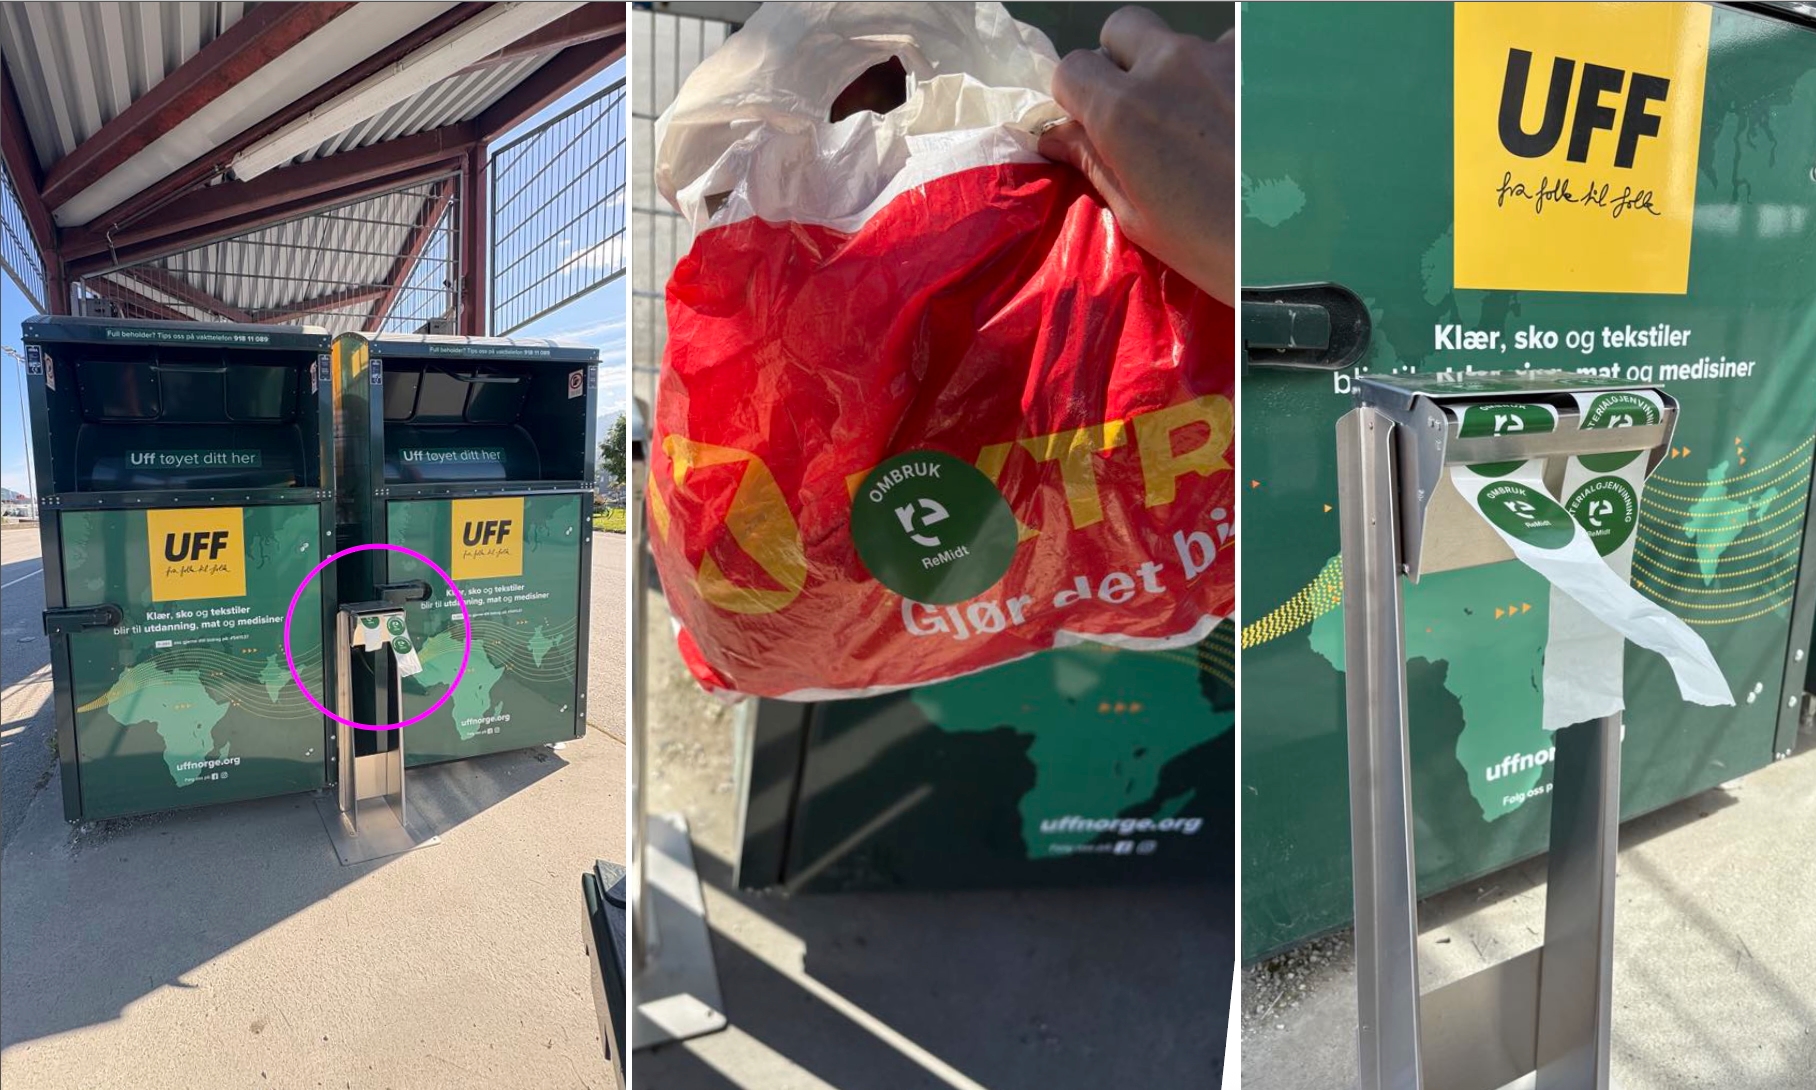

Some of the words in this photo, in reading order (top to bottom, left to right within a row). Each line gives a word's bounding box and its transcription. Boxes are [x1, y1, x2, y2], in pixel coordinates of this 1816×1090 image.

[1498, 47, 1671, 170] UFF
[1496, 171, 1533, 208] fra
[1580, 181, 1608, 208] til
[1434, 324, 1507, 353] Klær,
[1514, 324, 1558, 351] sko
[1565, 328, 1595, 354] og
[1601, 325, 1692, 350] tekstiler
[1659, 356, 1756, 381] medisiner
[131, 452, 155, 465] Uff
[160, 453, 199, 469] tøyet
[203, 451, 228, 465] ditt
[232, 451, 256, 465] her
[403, 450, 423, 462] Uff
[426, 449, 457, 465] tøyet
[460, 448, 480, 462] ditt
[483, 448, 501, 461] her
[869, 462, 941, 503] OMBRUK
[1486, 486, 1527, 499] OMBRUK
[463, 519, 512, 547] UFF
[165, 530, 229, 563] UFF
[922, 545, 970, 569] ReMidt
[420, 601, 433, 610] blir
[487, 594, 502, 604] mat
[503, 595, 513, 603] og
[514, 591, 550, 601] medisiner
[468, 587, 482, 596] sko
[483, 587, 494, 595] og
[495, 584, 525, 593] tekstiler
[146, 610, 173, 621] Klær,
[176, 609, 193, 619] sko
[196, 609, 209, 618] og
[211, 605, 251, 616] tekstiler
[901, 593, 1034, 640] Gjør
[113, 626, 130, 636] blir
[132, 624, 142, 634] til
[144, 620, 199, 633] utdanning,
[201, 618, 221, 629] mat
[223, 619, 236, 629] og
[237, 615, 285, 627] medisiner
[461, 713, 511, 727] uffnorge.org
[176, 756, 241, 771] uffnorge.org
[1503, 792, 1526, 807] Følg
[1527, 785, 1544, 798] oss
[1040, 815, 1202, 835] uffnorge.org
